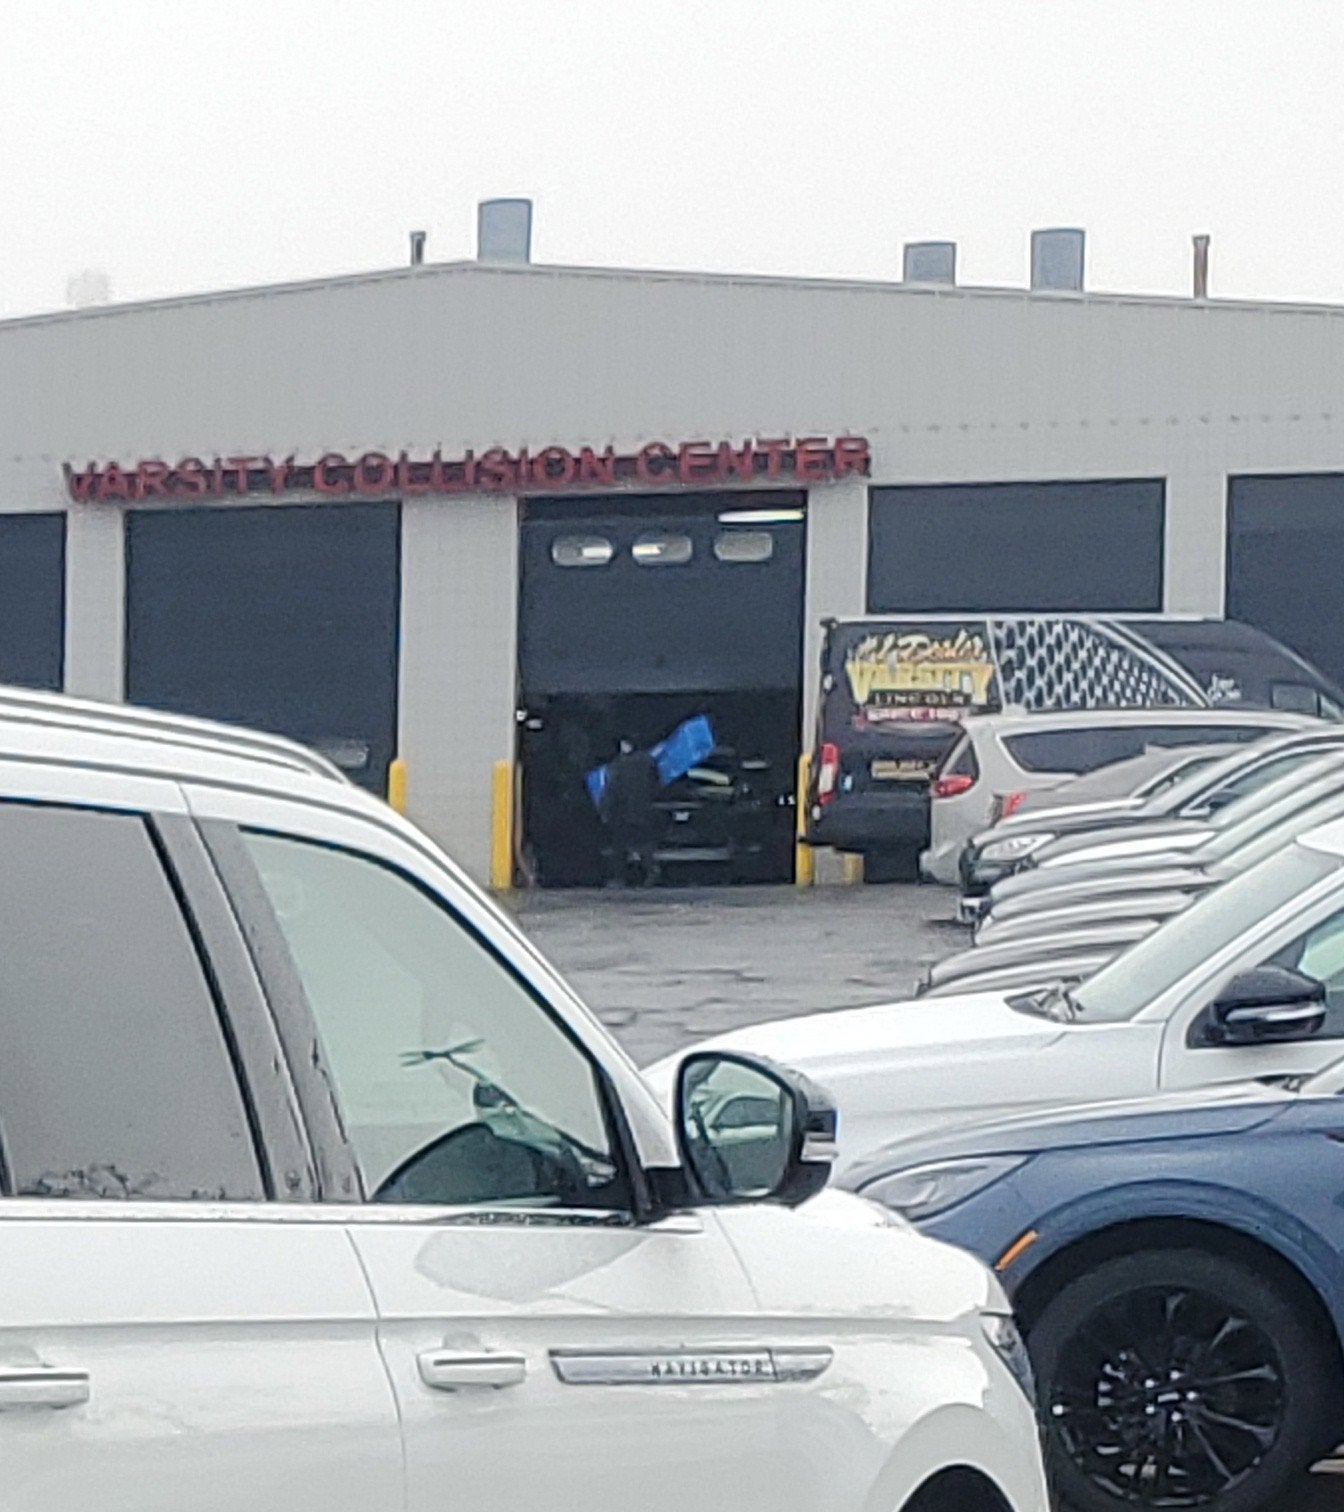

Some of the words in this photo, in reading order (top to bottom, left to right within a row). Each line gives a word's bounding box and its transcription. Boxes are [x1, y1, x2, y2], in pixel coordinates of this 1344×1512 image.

[62, 455, 295, 502] VARSITY
[313, 443, 615, 494] COLLISION
[637, 436, 872, 485] CENTER
[650, 1359, 764, 1377] NAVIGATOR
